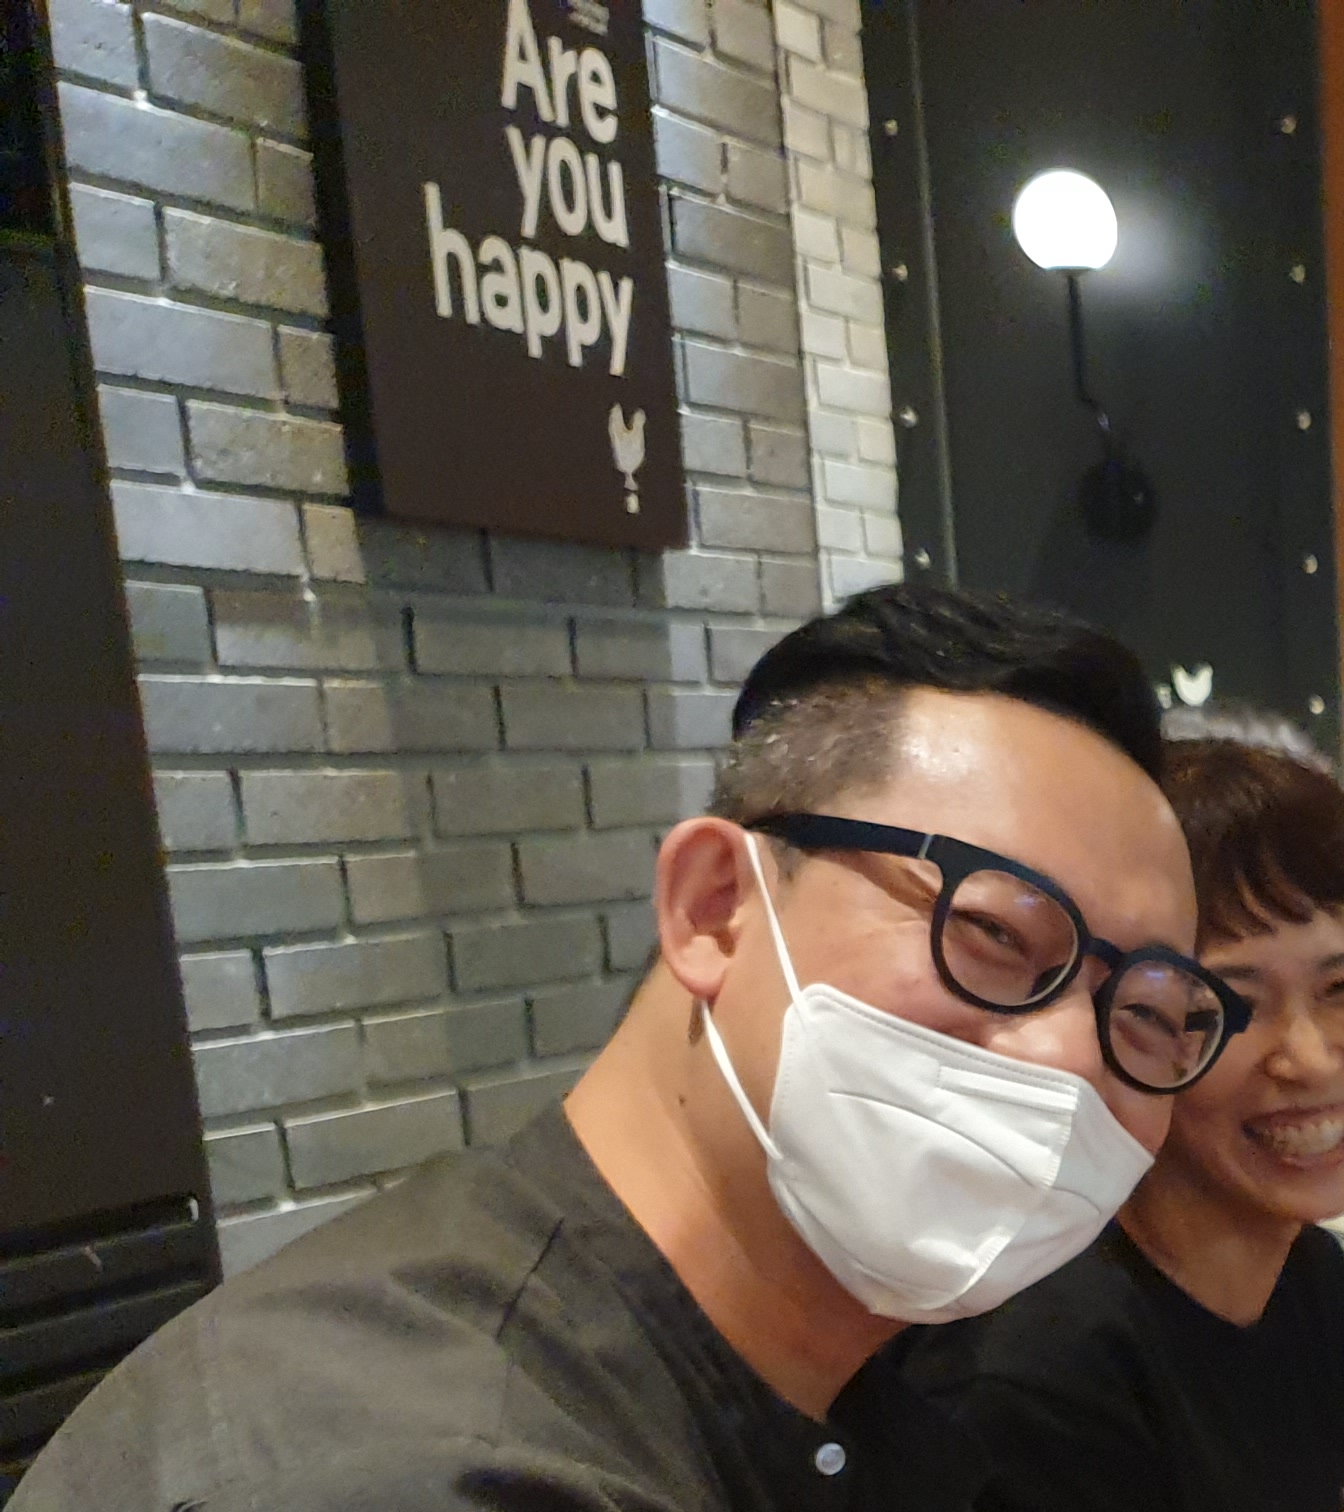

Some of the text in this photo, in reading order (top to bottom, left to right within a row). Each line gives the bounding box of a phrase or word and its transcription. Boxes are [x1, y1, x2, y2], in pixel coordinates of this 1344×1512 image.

[502, 0, 617, 143] Are
[506, 125, 630, 248] you
[425, 182, 633, 377] happy
